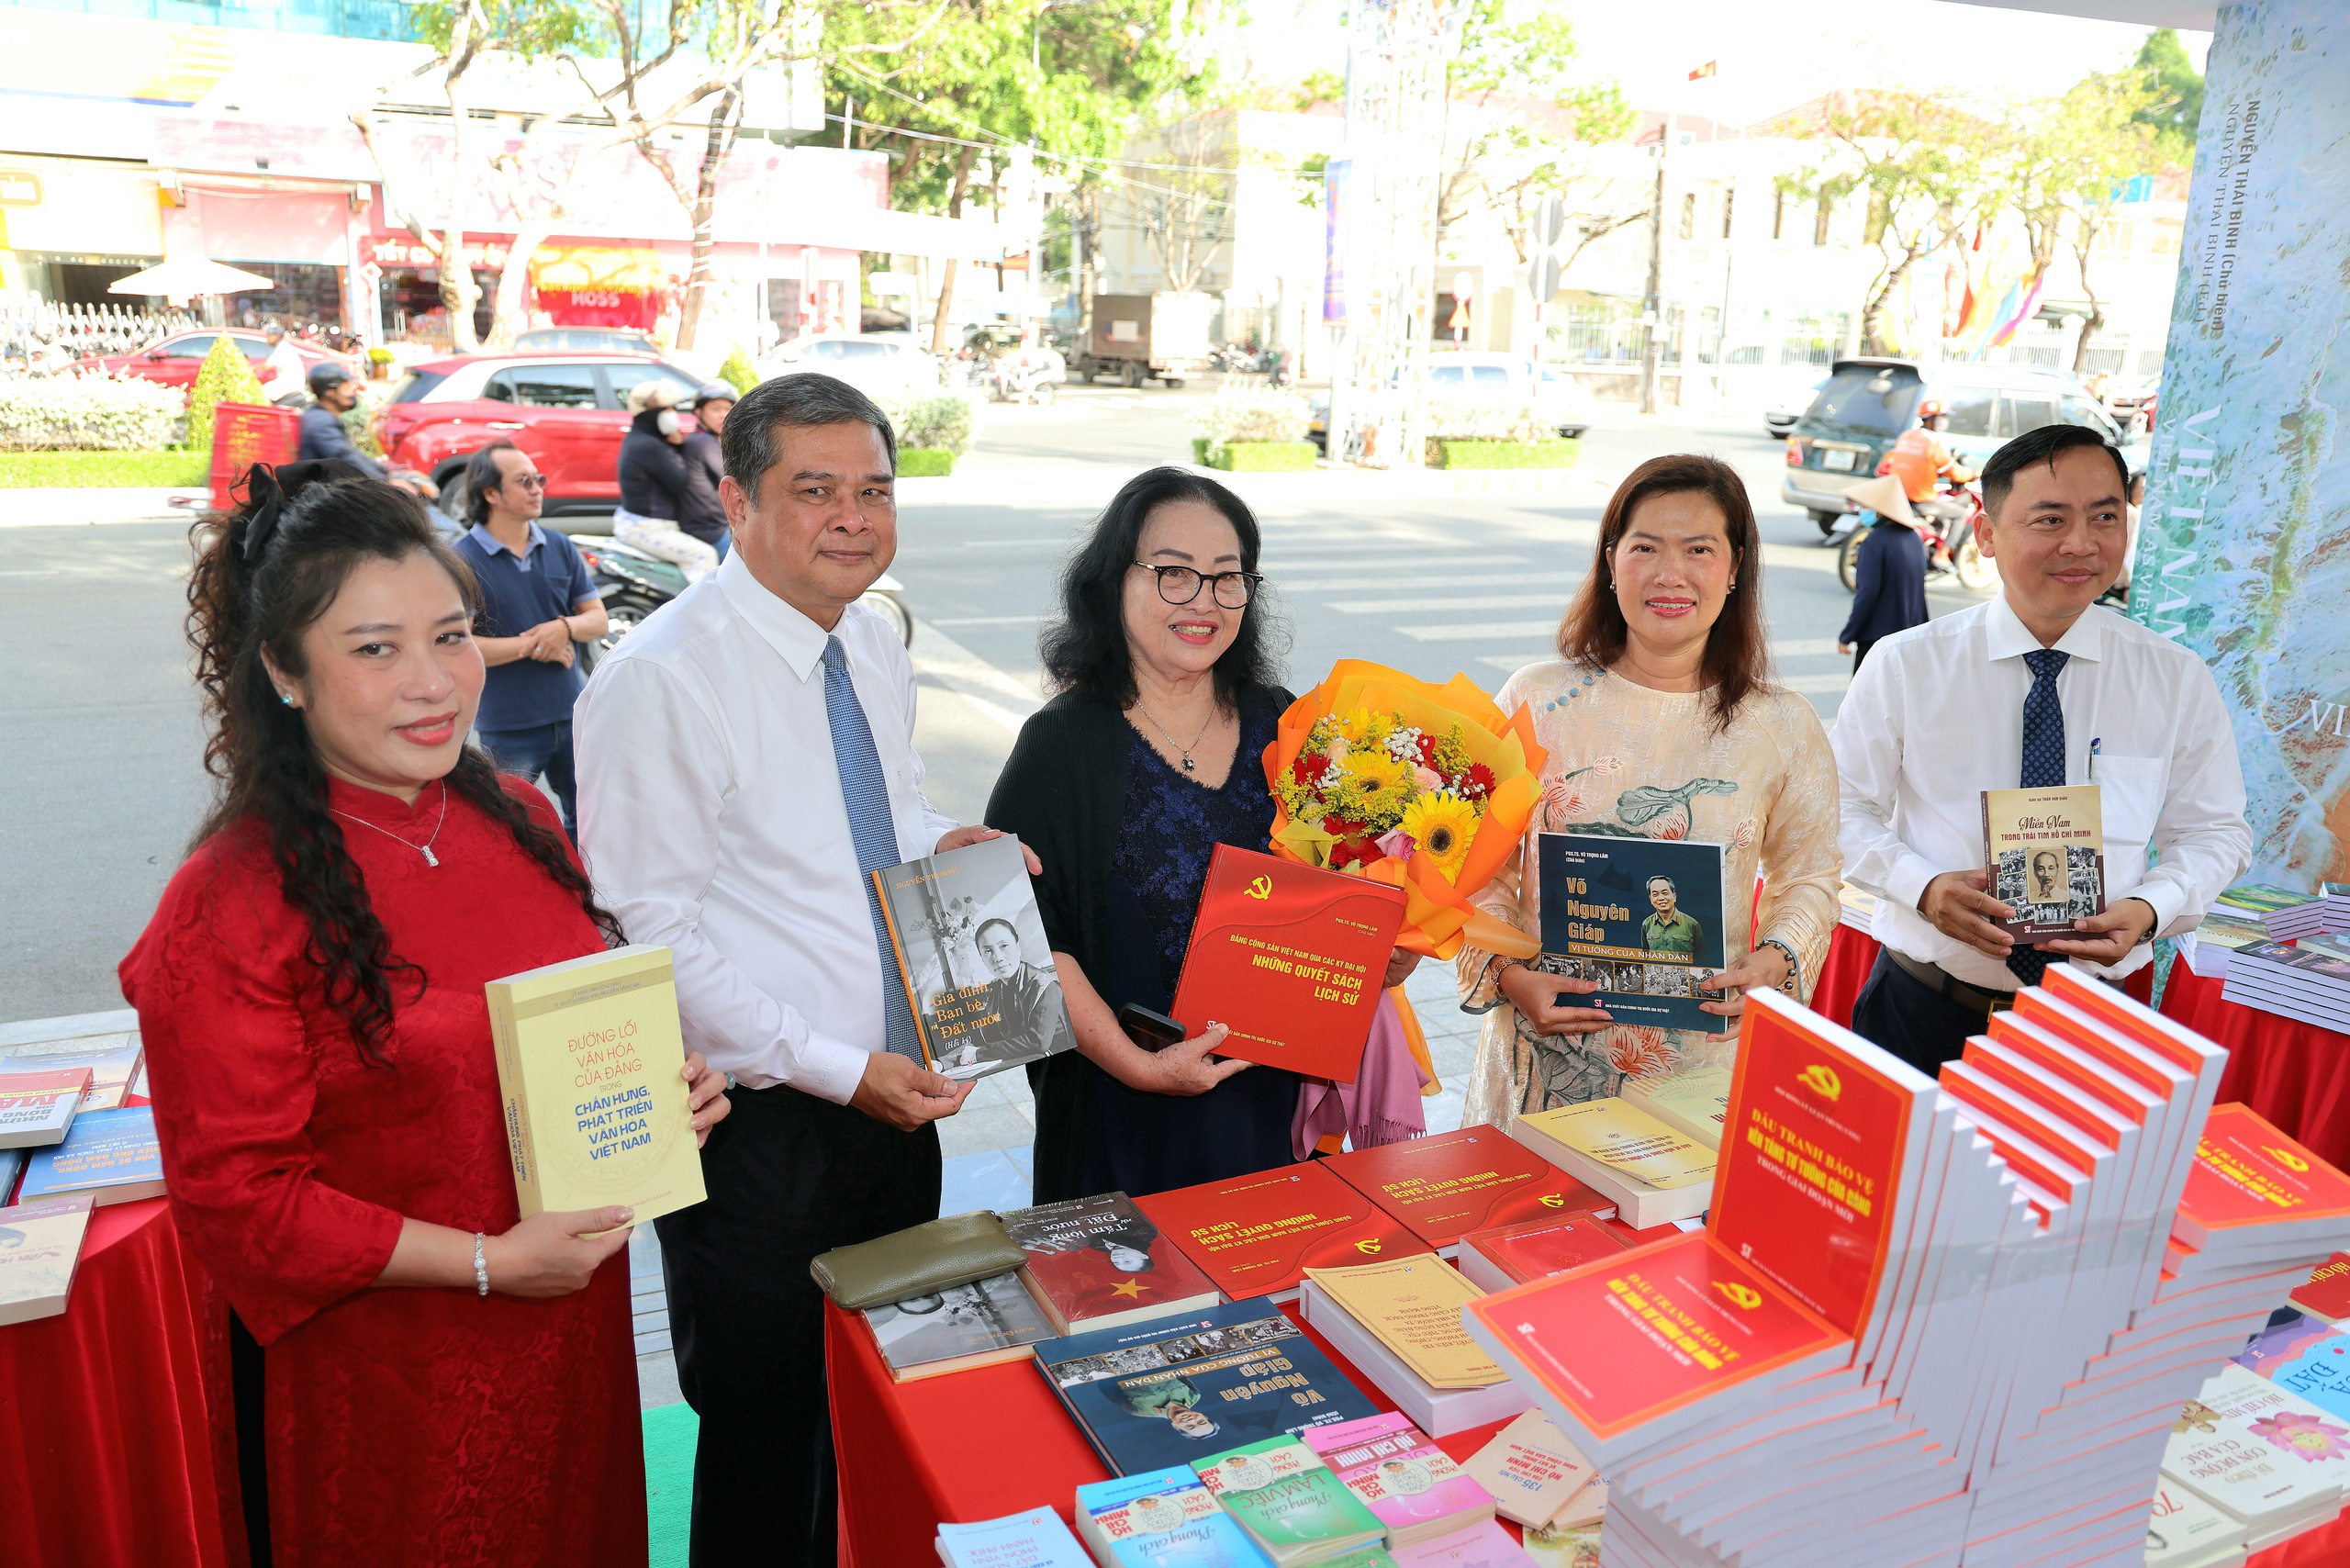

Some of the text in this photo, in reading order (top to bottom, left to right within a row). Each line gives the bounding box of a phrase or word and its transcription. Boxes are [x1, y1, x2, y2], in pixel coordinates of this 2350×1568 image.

[2210, 101, 2260, 332] NGUYỄN THÁI BÌNH (Chủ biên)
[2154, 418, 2177, 472] VIET
[2158, 403, 2227, 532] VIỆT
[2147, 479, 2168, 531] NAM
[2141, 538, 2160, 566] AS
[2019, 815, 2070, 831] Miền Nam
[2052, 830, 2059, 838] HỒ
[2062, 830, 2072, 838] CHÍ
[895, 866, 958, 889] NGUYỄN THỊ BÌNH
[1566, 878, 1586, 894] Võ
[1568, 900, 1628, 921] Nguyên
[1568, 923, 1604, 943] Giáp
[1230, 935, 1366, 973] ĐẢNG CỘNG SẢN VIỆT NAM QUA CÁC KỲ ĐẠI HỘI
[1572, 942, 1689, 963] VỊ TƯỚNG CỦA NHÂN DÂN
[1252, 955, 1362, 990] NHỮNG QUYẾT SÁCH
[930, 976, 992, 1009] Gia đình,
[1315, 986, 1360, 1005] LỊCH SỬ
[935, 995, 983, 1024] Bạn bè
[568, 1019, 637, 1052] ĐƯỜNG LỐI
[938, 1008, 1003, 1039] Đất nước
[576, 1042, 634, 1068] VĂN HÓA
[575, 1058, 642, 1088] CỦA ĐẢNG
[599, 1081, 622, 1092] TRONG
[576, 1086, 650, 1115] CHẤN HƯNG,
[578, 1094, 653, 1132] PHÁT TRIỂN
[588, 1118, 647, 1144] VĂN HÓA
[589, 1133, 651, 1159] VIỆT NAM
[1752, 1109, 1874, 1195] ĐẤU TRANH BẢO VỆ
[1378, 1178, 1427, 1193] LỊCH SỬ
[1391, 1171, 1499, 1198] NHỮNG QUYẾT SÁCH
[1756, 1156, 1853, 1225] TRONG GIAI ĐOẠN MỚI
[1041, 1214, 1121, 1231] Đất nước
[1049, 1222, 1127, 1243] Tấm lòng
[1186, 1222, 1238, 1238] LỊCH SỬ
[1199, 1214, 1317, 1245] NHỮNG QUYẾT SÁCH
[1125, 1347, 1276, 1389] VỊ TƯỚNG CỦA NHÂN DÂN
[1239, 1358, 1292, 1377] Giáp
[2284, 1361, 2339, 1393] ĐẤT
[1219, 1372, 1309, 1401] Nguyên
[1292, 1389, 1326, 1406] Võ
[1331, 1435, 1416, 1467] HỒ CHÍ MINH
[1506, 1457, 1562, 1482] HỒ CHÍ MINH
[1233, 1473, 1328, 1510] LÀM VIỆC
[1091, 1509, 1132, 1525] MINH
[1104, 1519, 1129, 1530] CHÍ
[1109, 1526, 1136, 1538] HỒ
